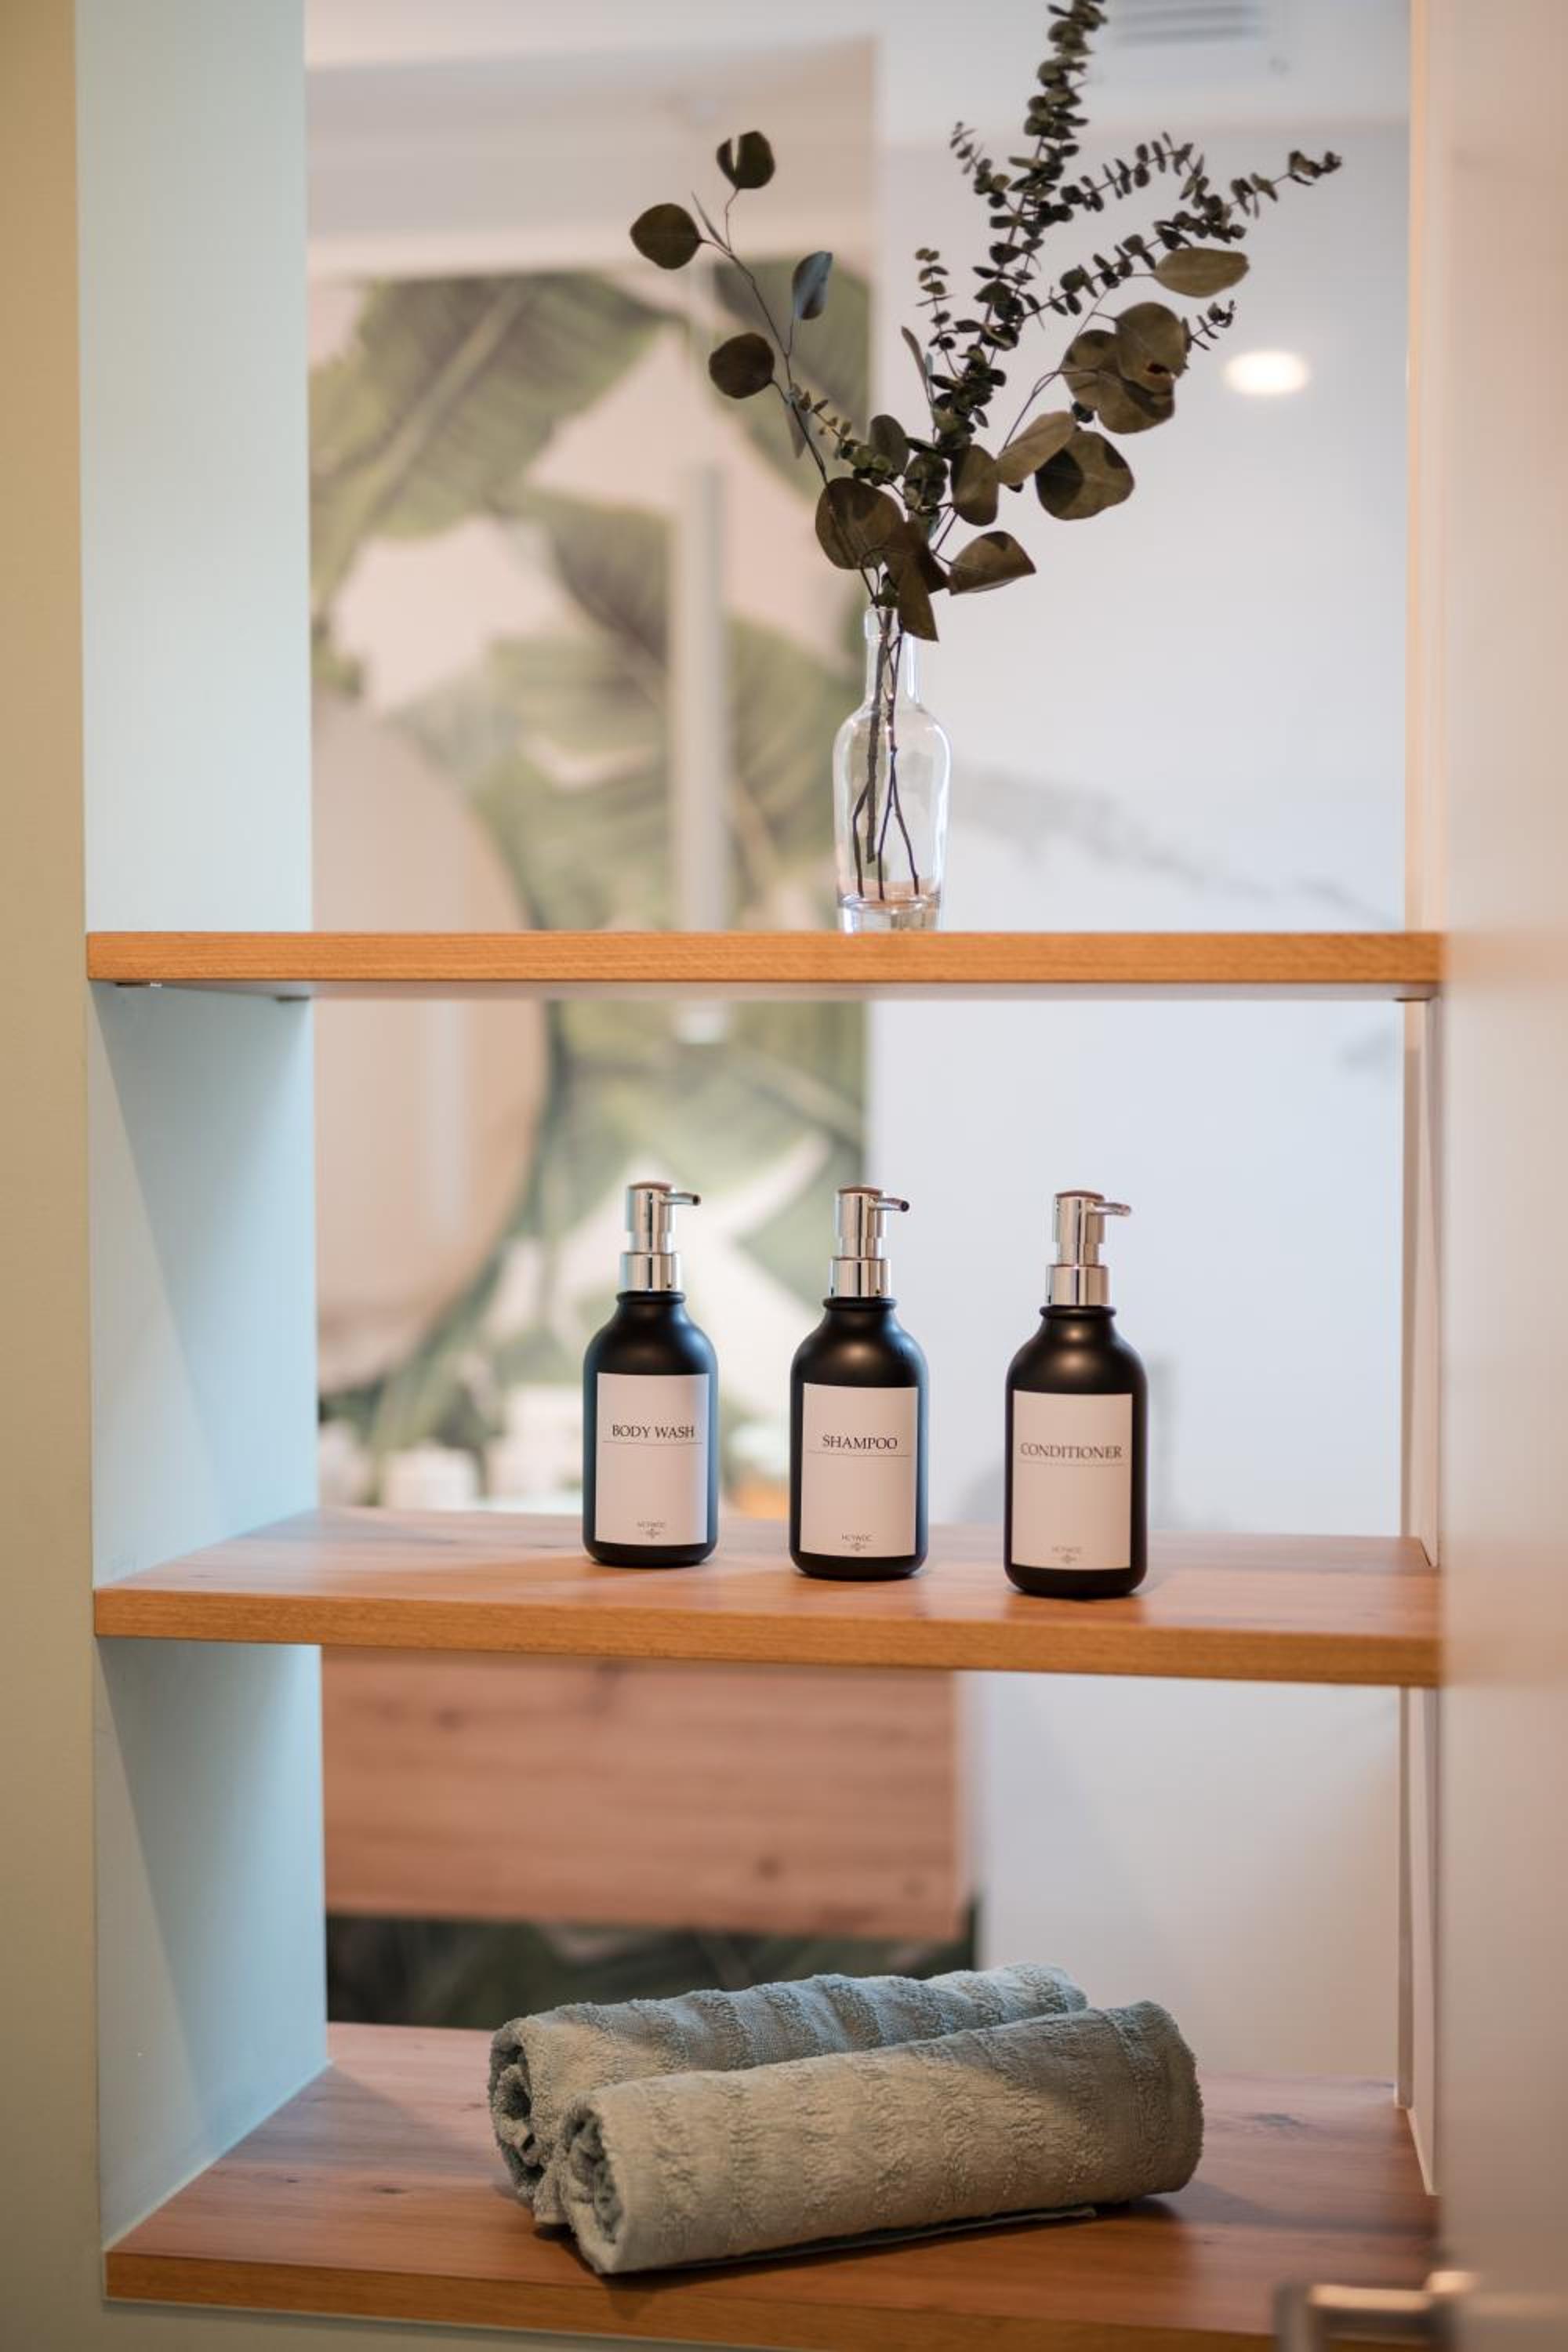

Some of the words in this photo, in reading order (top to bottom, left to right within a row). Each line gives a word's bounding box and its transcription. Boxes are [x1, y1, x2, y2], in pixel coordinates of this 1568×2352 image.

[612, 1425, 652, 1438] BODY
[655, 1425, 695, 1439] WASH
[822, 1434, 898, 1450] SHAMPOO
[1020, 1443, 1123, 1459] CONDITIONER
